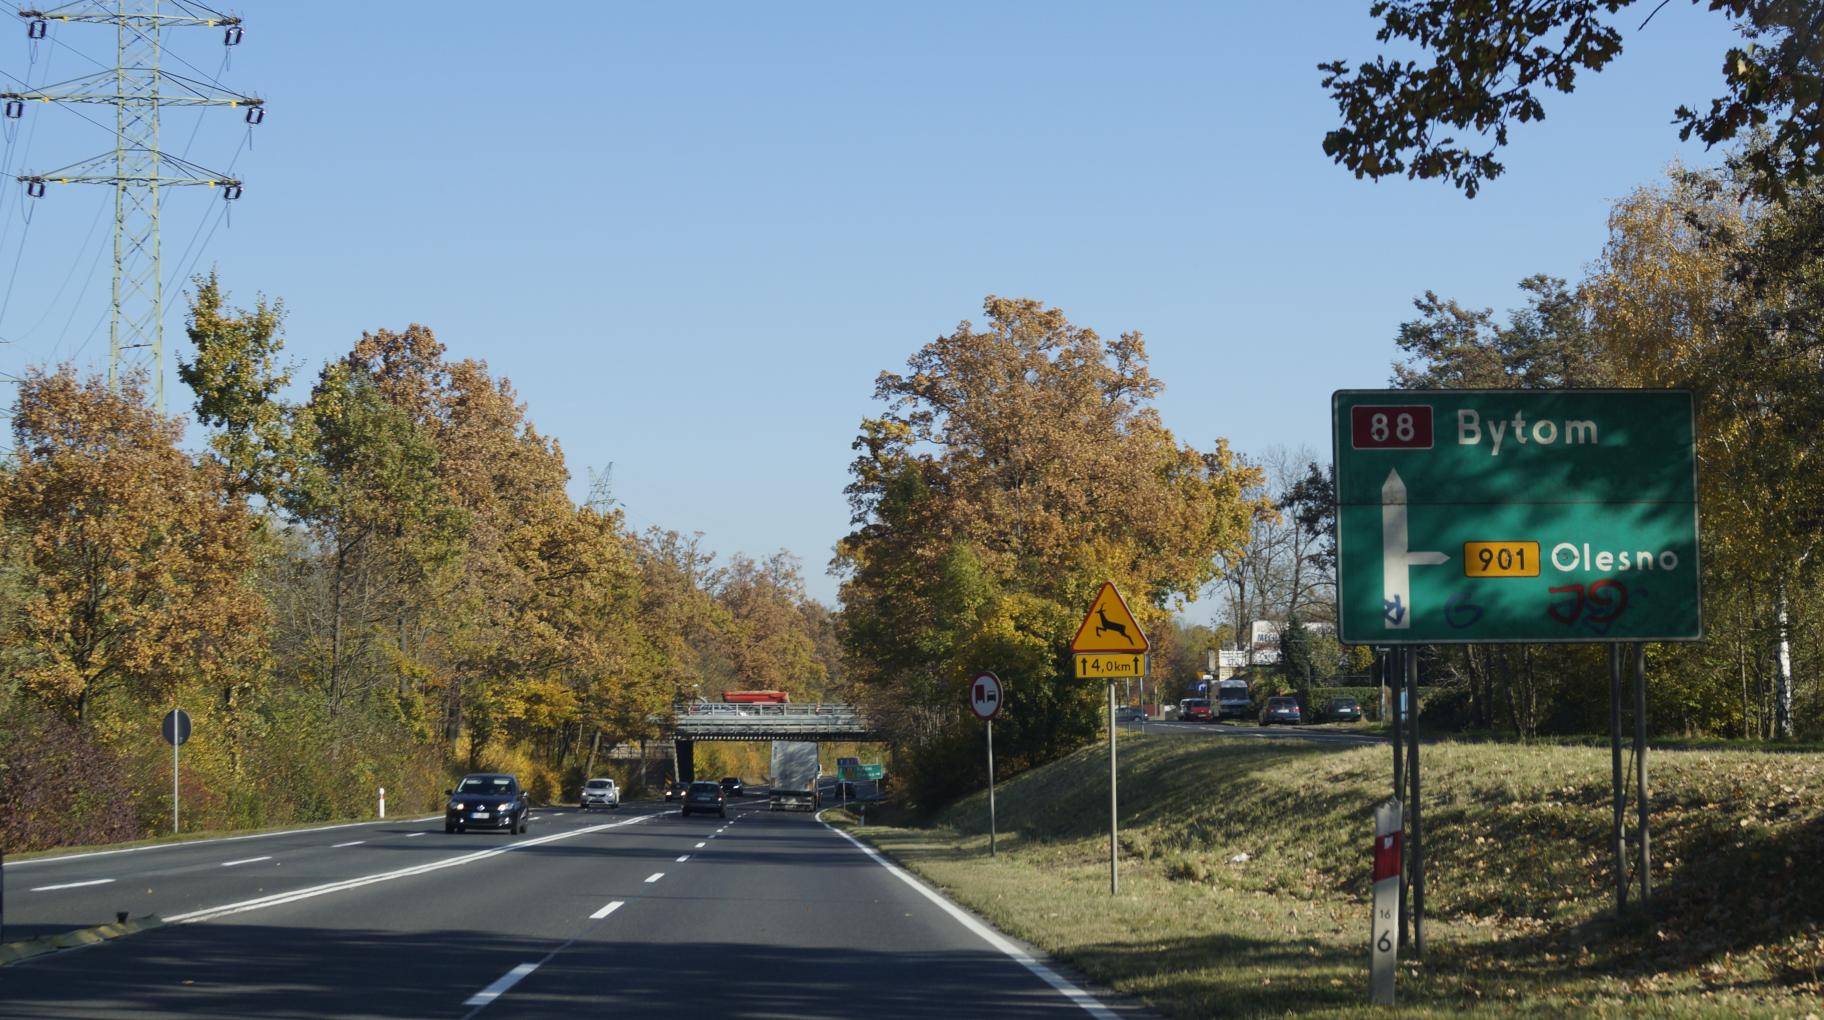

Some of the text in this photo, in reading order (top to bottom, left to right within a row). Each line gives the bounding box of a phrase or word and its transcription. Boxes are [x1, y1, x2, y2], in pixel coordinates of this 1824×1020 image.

[1371, 409, 1598, 456] 88 Bytom
[1478, 541, 1679, 573] 901 Olesno
[1379, 909, 1391, 920] 16
[1377, 930, 1392, 953] 6
